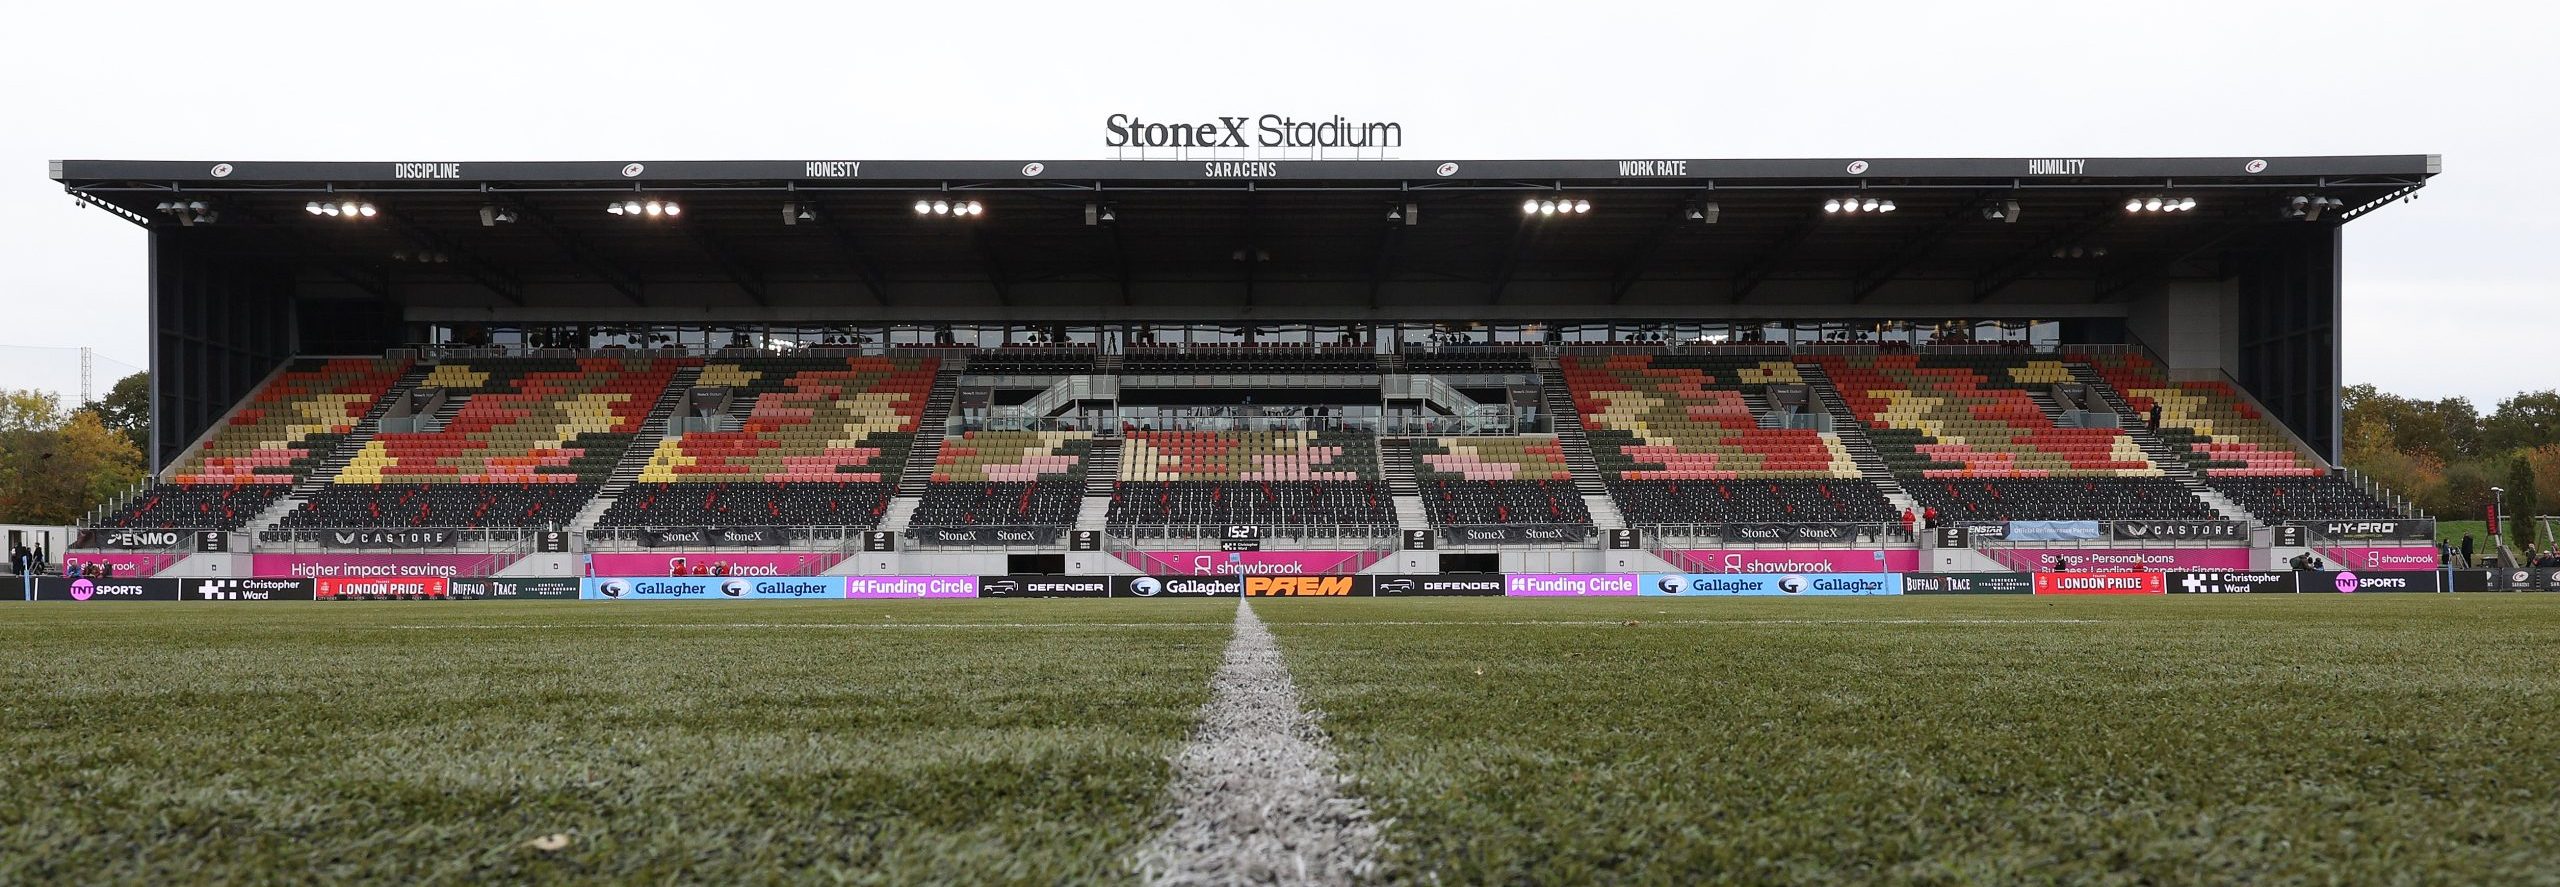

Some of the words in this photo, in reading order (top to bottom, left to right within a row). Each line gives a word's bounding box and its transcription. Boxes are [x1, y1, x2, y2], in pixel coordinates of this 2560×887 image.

[1106, 113, 1249, 147] StoneX
[1258, 114, 1401, 147] Stadium
[395, 162, 460, 179] DISCIPLINE
[806, 161, 860, 178] HONESTY
[1205, 162, 1276, 177] SARACENS
[1619, 160, 1654, 176] WORK
[1657, 160, 1687, 176] RATE
[2029, 159, 2085, 175] HUMILITY
[1228, 526, 1258, 538] 15:27
[1525, 528, 1563, 538] StoneX
[1741, 528, 1779, 538] StoneX
[1800, 527, 1838, 537] StoneX
[1969, 525, 2003, 533] ENSTAR
[2154, 525, 2234, 535] CASTORE
[2328, 522, 2394, 533] HY-PRO
[361, 533, 443, 543] CASTORE
[662, 532, 700, 542] StoneX
[724, 531, 762, 541] StoneX
[939, 530, 977, 540] StoneX
[997, 530, 1035, 540] StoneX
[1467, 529, 1505, 539] StoneX
[2142, 554, 2174, 564] Loans
[2381, 554, 2433, 563] shawbrook
[292, 562, 340, 578] Higher
[344, 562, 397, 578] impact
[401, 562, 457, 578] savings
[1217, 560, 1303, 574] shawbrook
[1747, 559, 1832, 573] shawbrook
[1907, 577, 1939, 591] BUFFALO
[1946, 577, 1971, 591] TRACE
[2057, 577, 2105, 589] LONDON
[2108, 577, 2142, 589] PRIDE
[2223, 573, 2281, 584] Christopher
[2359, 578, 2406, 588] SPORTS
[96, 585, 143, 595] SPORTS
[242, 580, 300, 590] Christopher
[338, 583, 388, 595] LONDON
[390, 583, 424, 595] PRIDE
[493, 582, 517, 596] TRACE
[635, 582, 706, 596] Gallagher
[756, 582, 827, 596] Gallagher
[867, 579, 927, 596] Funding
[930, 579, 973, 594] Circle
[1028, 583, 1104, 592] DEFENDER
[1166, 580, 1240, 595] Gallagher
[1246, 577, 1352, 595] PREM
[1424, 582, 1500, 590] DEFENDER
[1527, 577, 1585, 594] Funding
[1589, 577, 1633, 592] Circle
[1693, 579, 1763, 593] Gallagher
[1813, 579, 1884, 593] Gallagher
[2223, 583, 2250, 593] Ward
[242, 590, 269, 600] Ward
